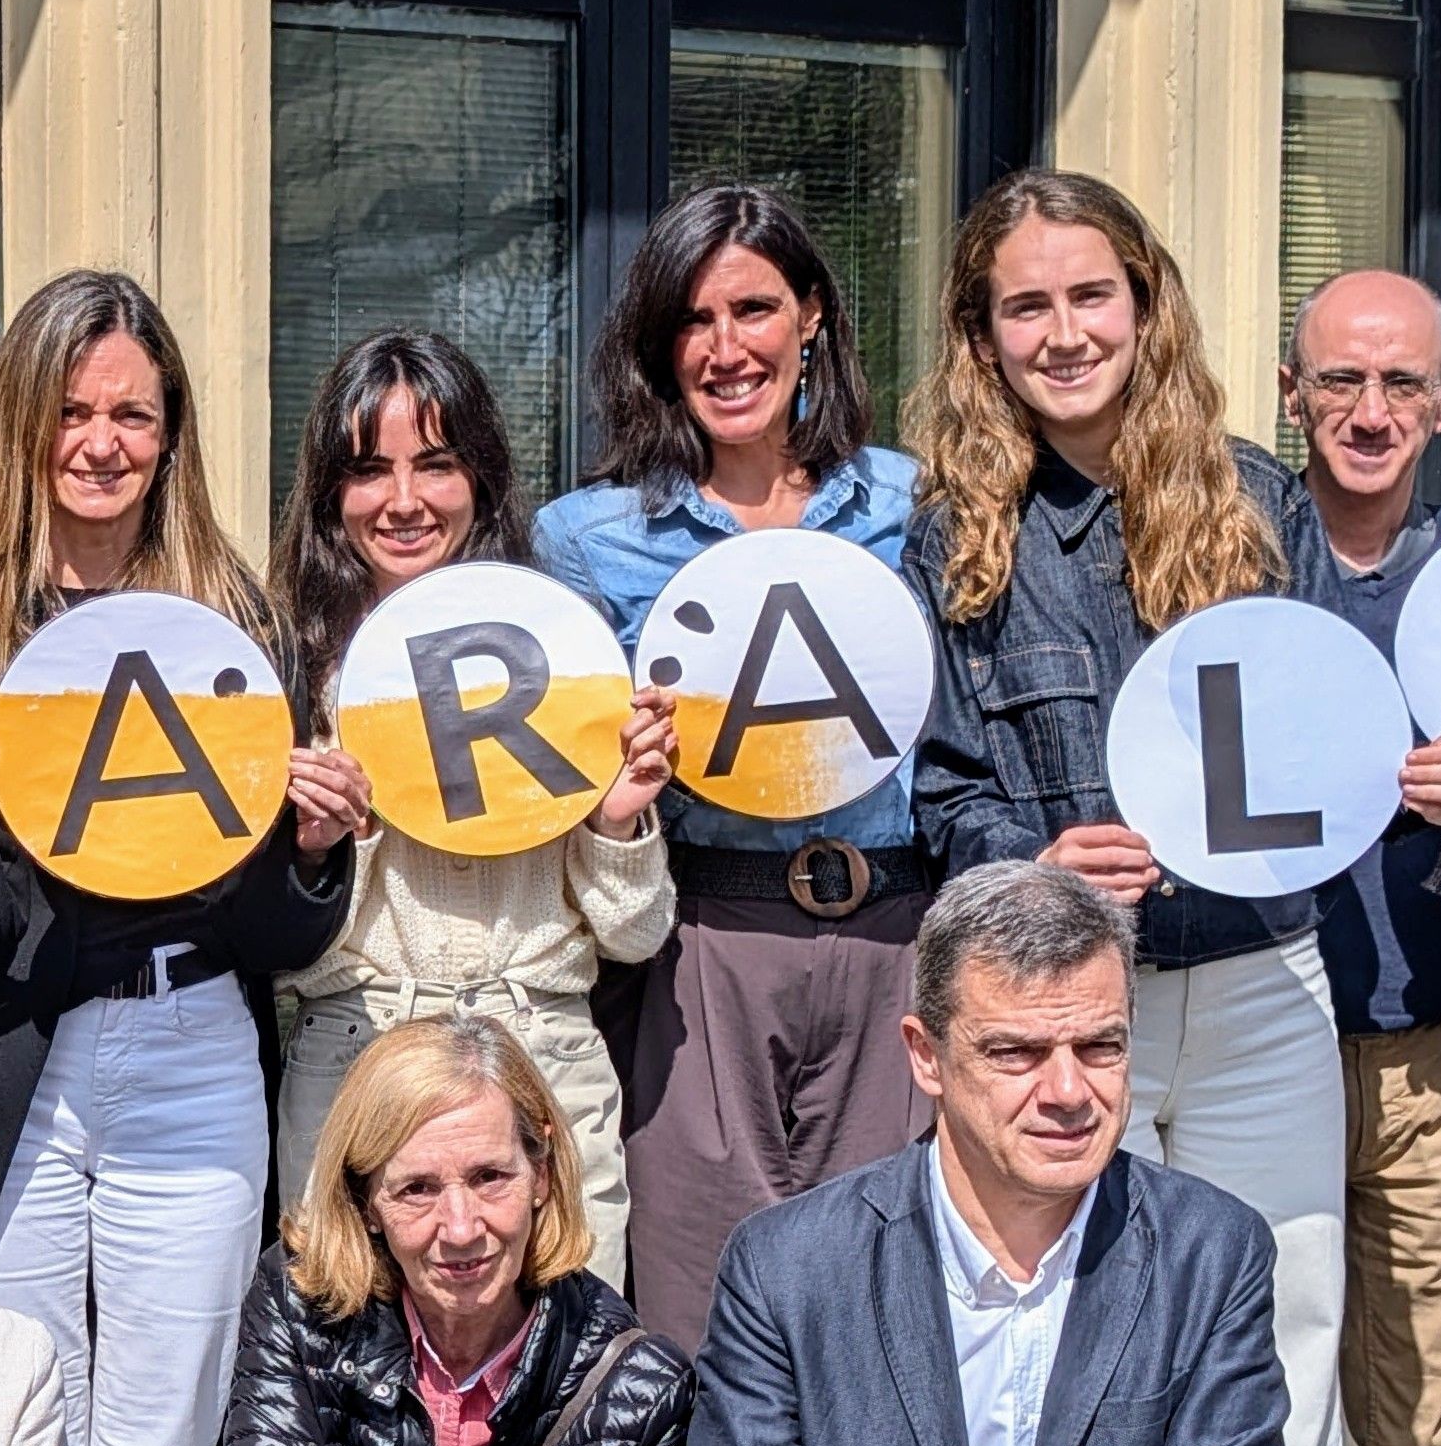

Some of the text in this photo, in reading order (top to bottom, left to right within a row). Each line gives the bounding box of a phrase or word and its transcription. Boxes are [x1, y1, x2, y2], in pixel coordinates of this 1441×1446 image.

[50, 650, 252, 857] A
[404, 619, 597, 822] R
[703, 582, 900, 779] A
[1196, 661, 1324, 854] L
